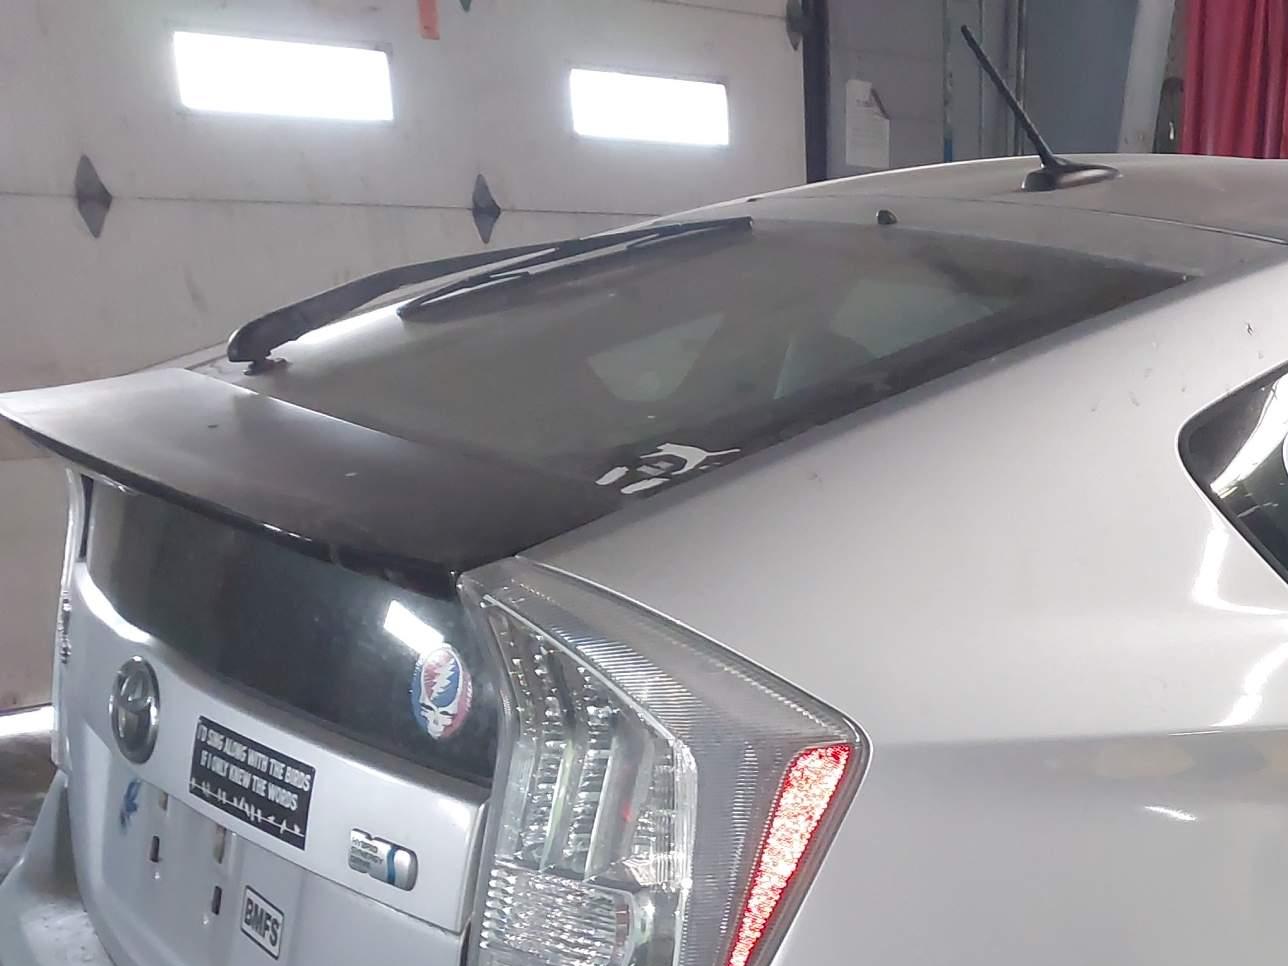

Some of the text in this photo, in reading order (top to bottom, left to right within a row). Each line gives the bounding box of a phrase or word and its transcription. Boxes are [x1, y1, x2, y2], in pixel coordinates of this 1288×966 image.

[206, 729, 224, 751] SING
[223, 737, 248, 762] ALONG
[247, 748, 269, 773] WITH
[268, 758, 286, 780] THE
[284, 766, 311, 791] BIRDS
[211, 755, 229, 777] ONLY
[228, 763, 252, 789] KNEW
[251, 774, 268, 797] THE
[267, 782, 298, 811] WORDS
[244, 897, 280, 947] BMFS
